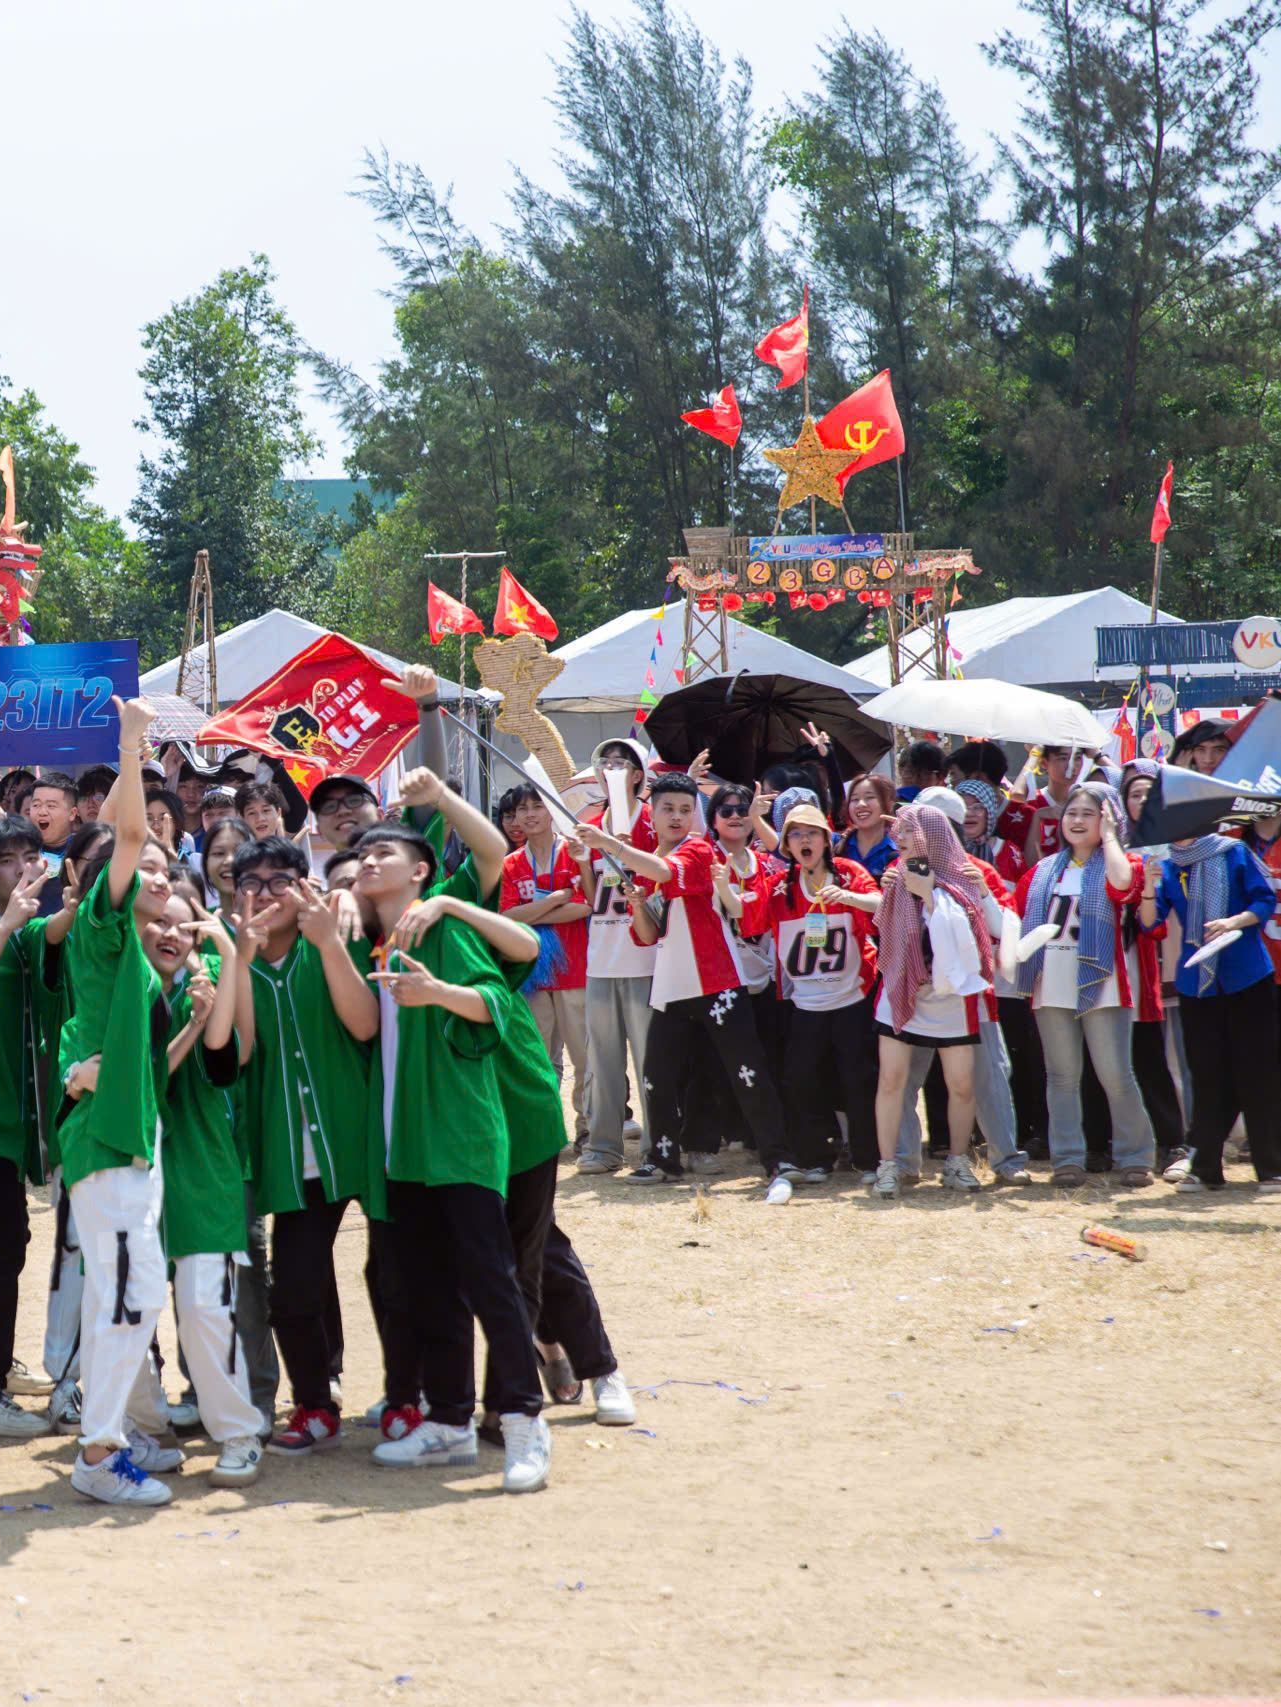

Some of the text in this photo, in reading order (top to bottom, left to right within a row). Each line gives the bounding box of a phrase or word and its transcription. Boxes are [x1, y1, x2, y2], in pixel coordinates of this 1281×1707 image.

[318, 678, 365, 722] TO PLAY
[786, 926, 847, 977] 09
